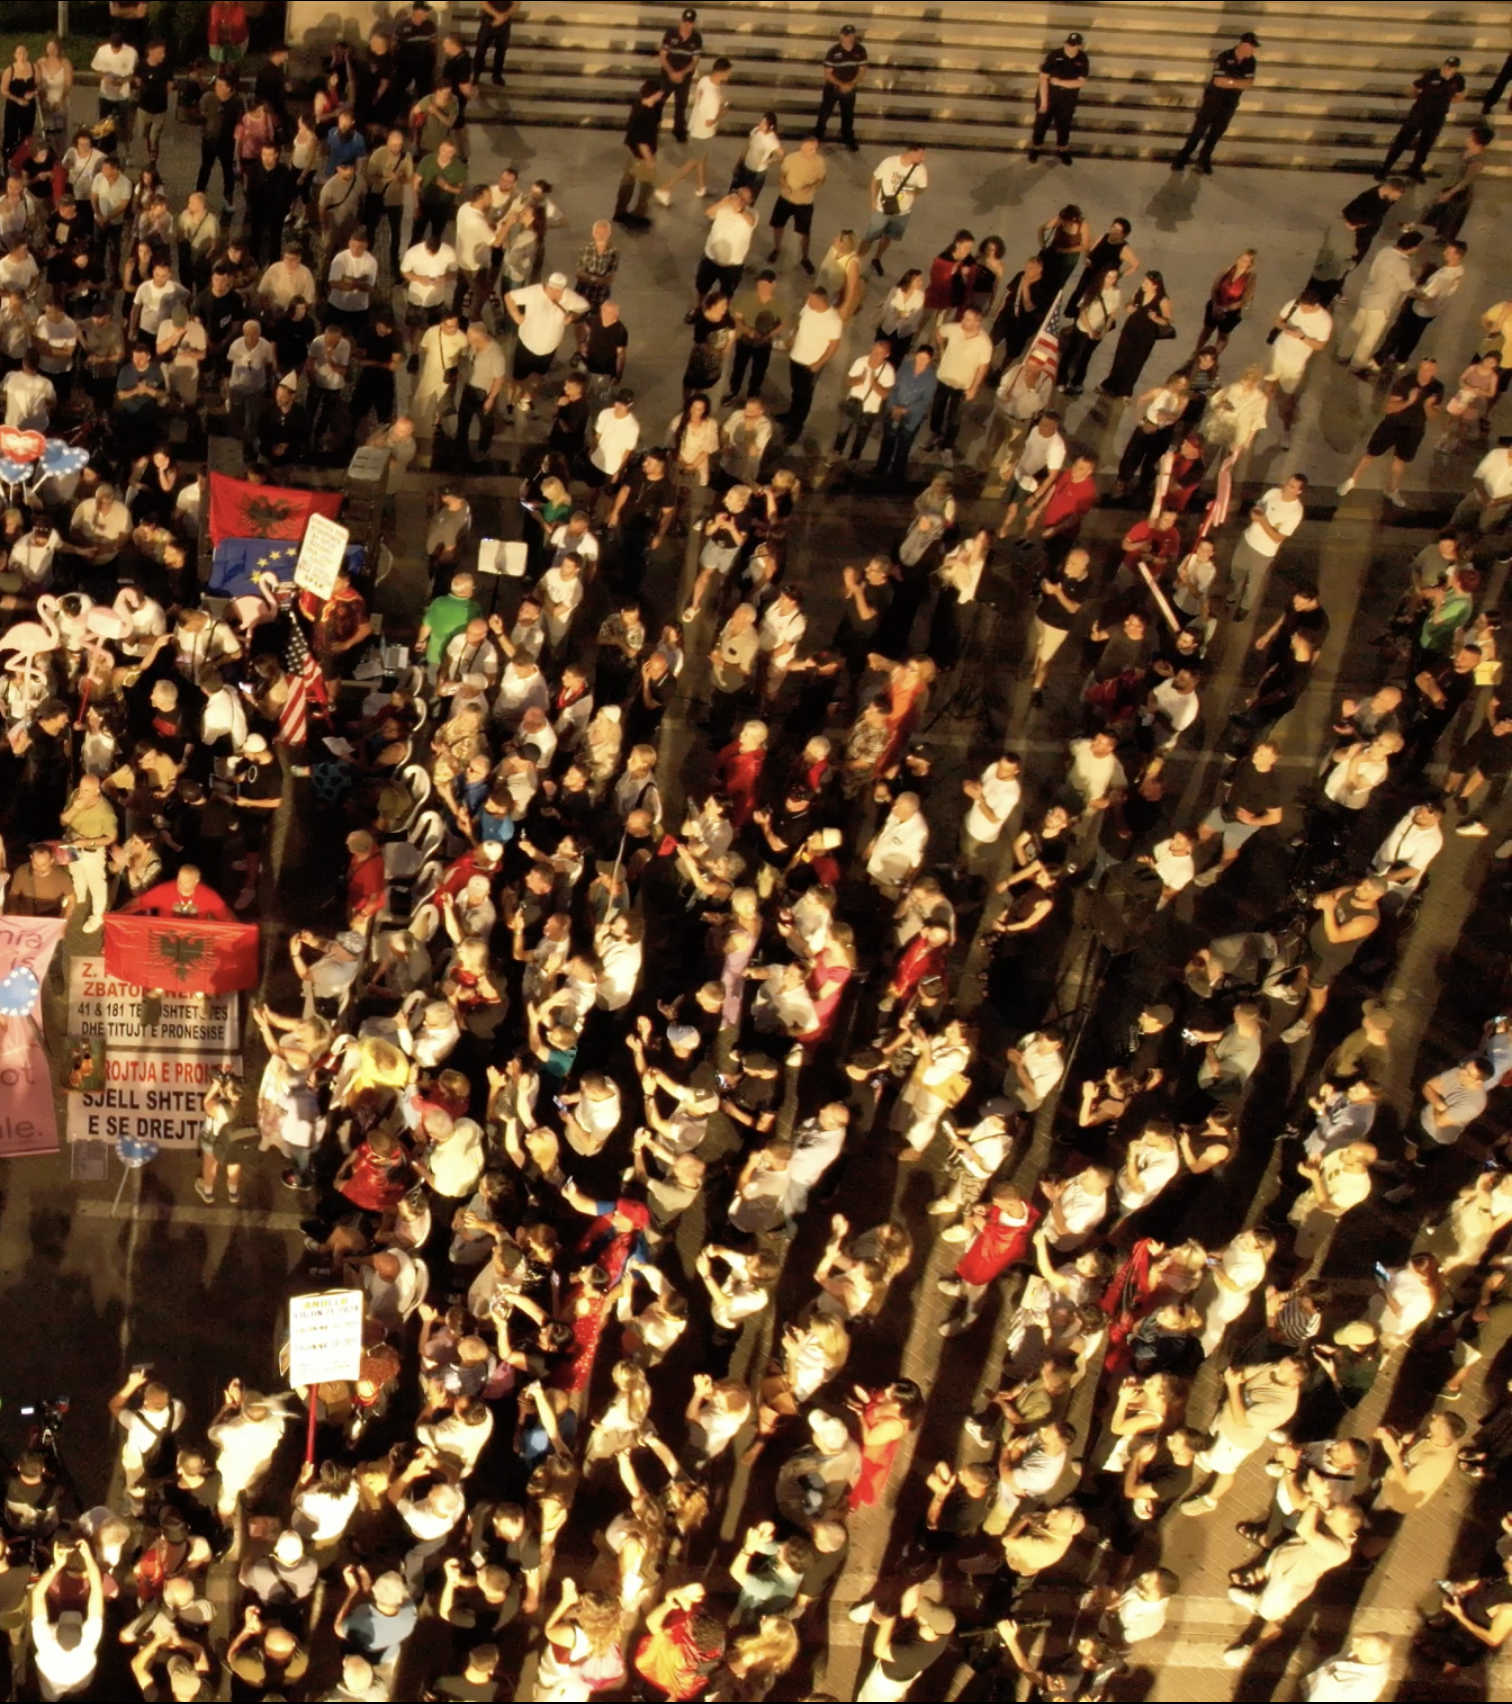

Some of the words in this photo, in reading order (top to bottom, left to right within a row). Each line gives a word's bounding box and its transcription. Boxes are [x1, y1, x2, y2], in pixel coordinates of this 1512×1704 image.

[10, 951, 36, 970] is
[78, 1001, 90, 1017] 41
[95, 1002, 103, 1017] &
[107, 1002, 124, 1017] 181
[82, 1021, 105, 1037] DHE
[107, 1022, 147, 1038] TITUJT
[151, 1024, 158, 1038] E
[161, 1023, 225, 1041] PRONESISE
[162, 1061, 170, 1083] E
[83, 1088, 140, 1110] SJELL
[88, 1114, 100, 1135] E
[106, 1115, 130, 1137] SE
[138, 1116, 204, 1140] DREJT
